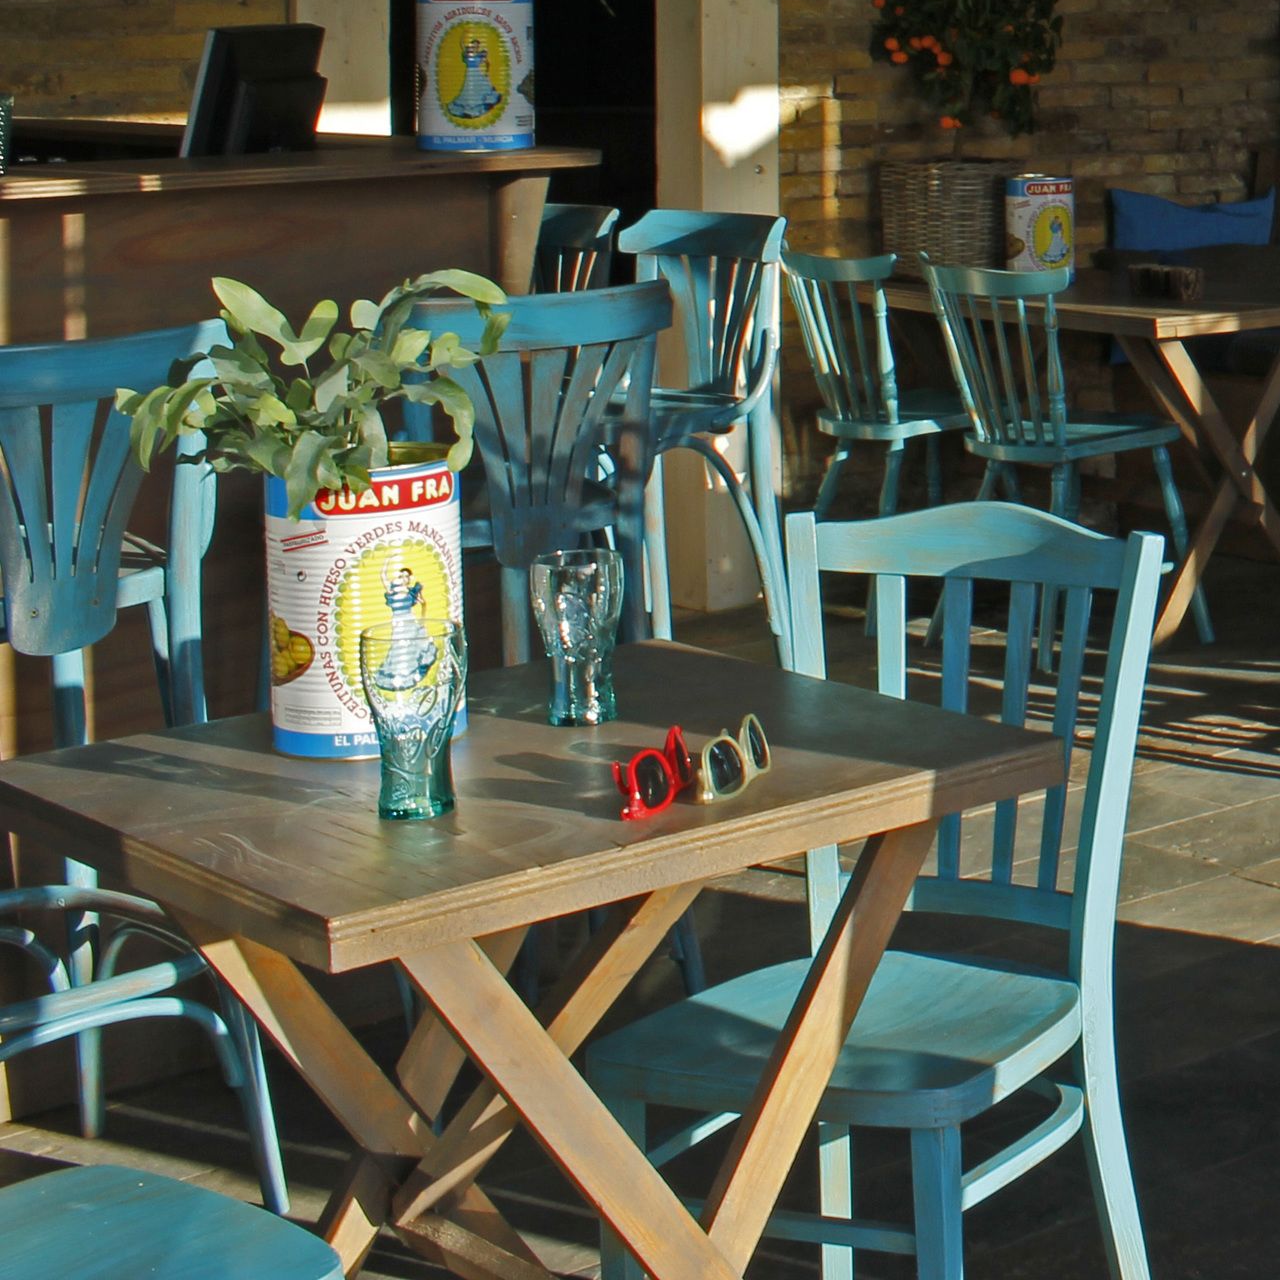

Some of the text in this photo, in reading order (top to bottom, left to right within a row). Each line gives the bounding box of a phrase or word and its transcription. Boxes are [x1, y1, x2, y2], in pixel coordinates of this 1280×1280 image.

[1027, 184, 1056, 194] JUAN
[320, 475, 451, 512] JUAN FRA
[344, 520, 403, 556] VERDES
[318, 558, 346, 607] HUESO
[316, 609, 330, 647] CON
[334, 733, 380, 747] EL PAL
